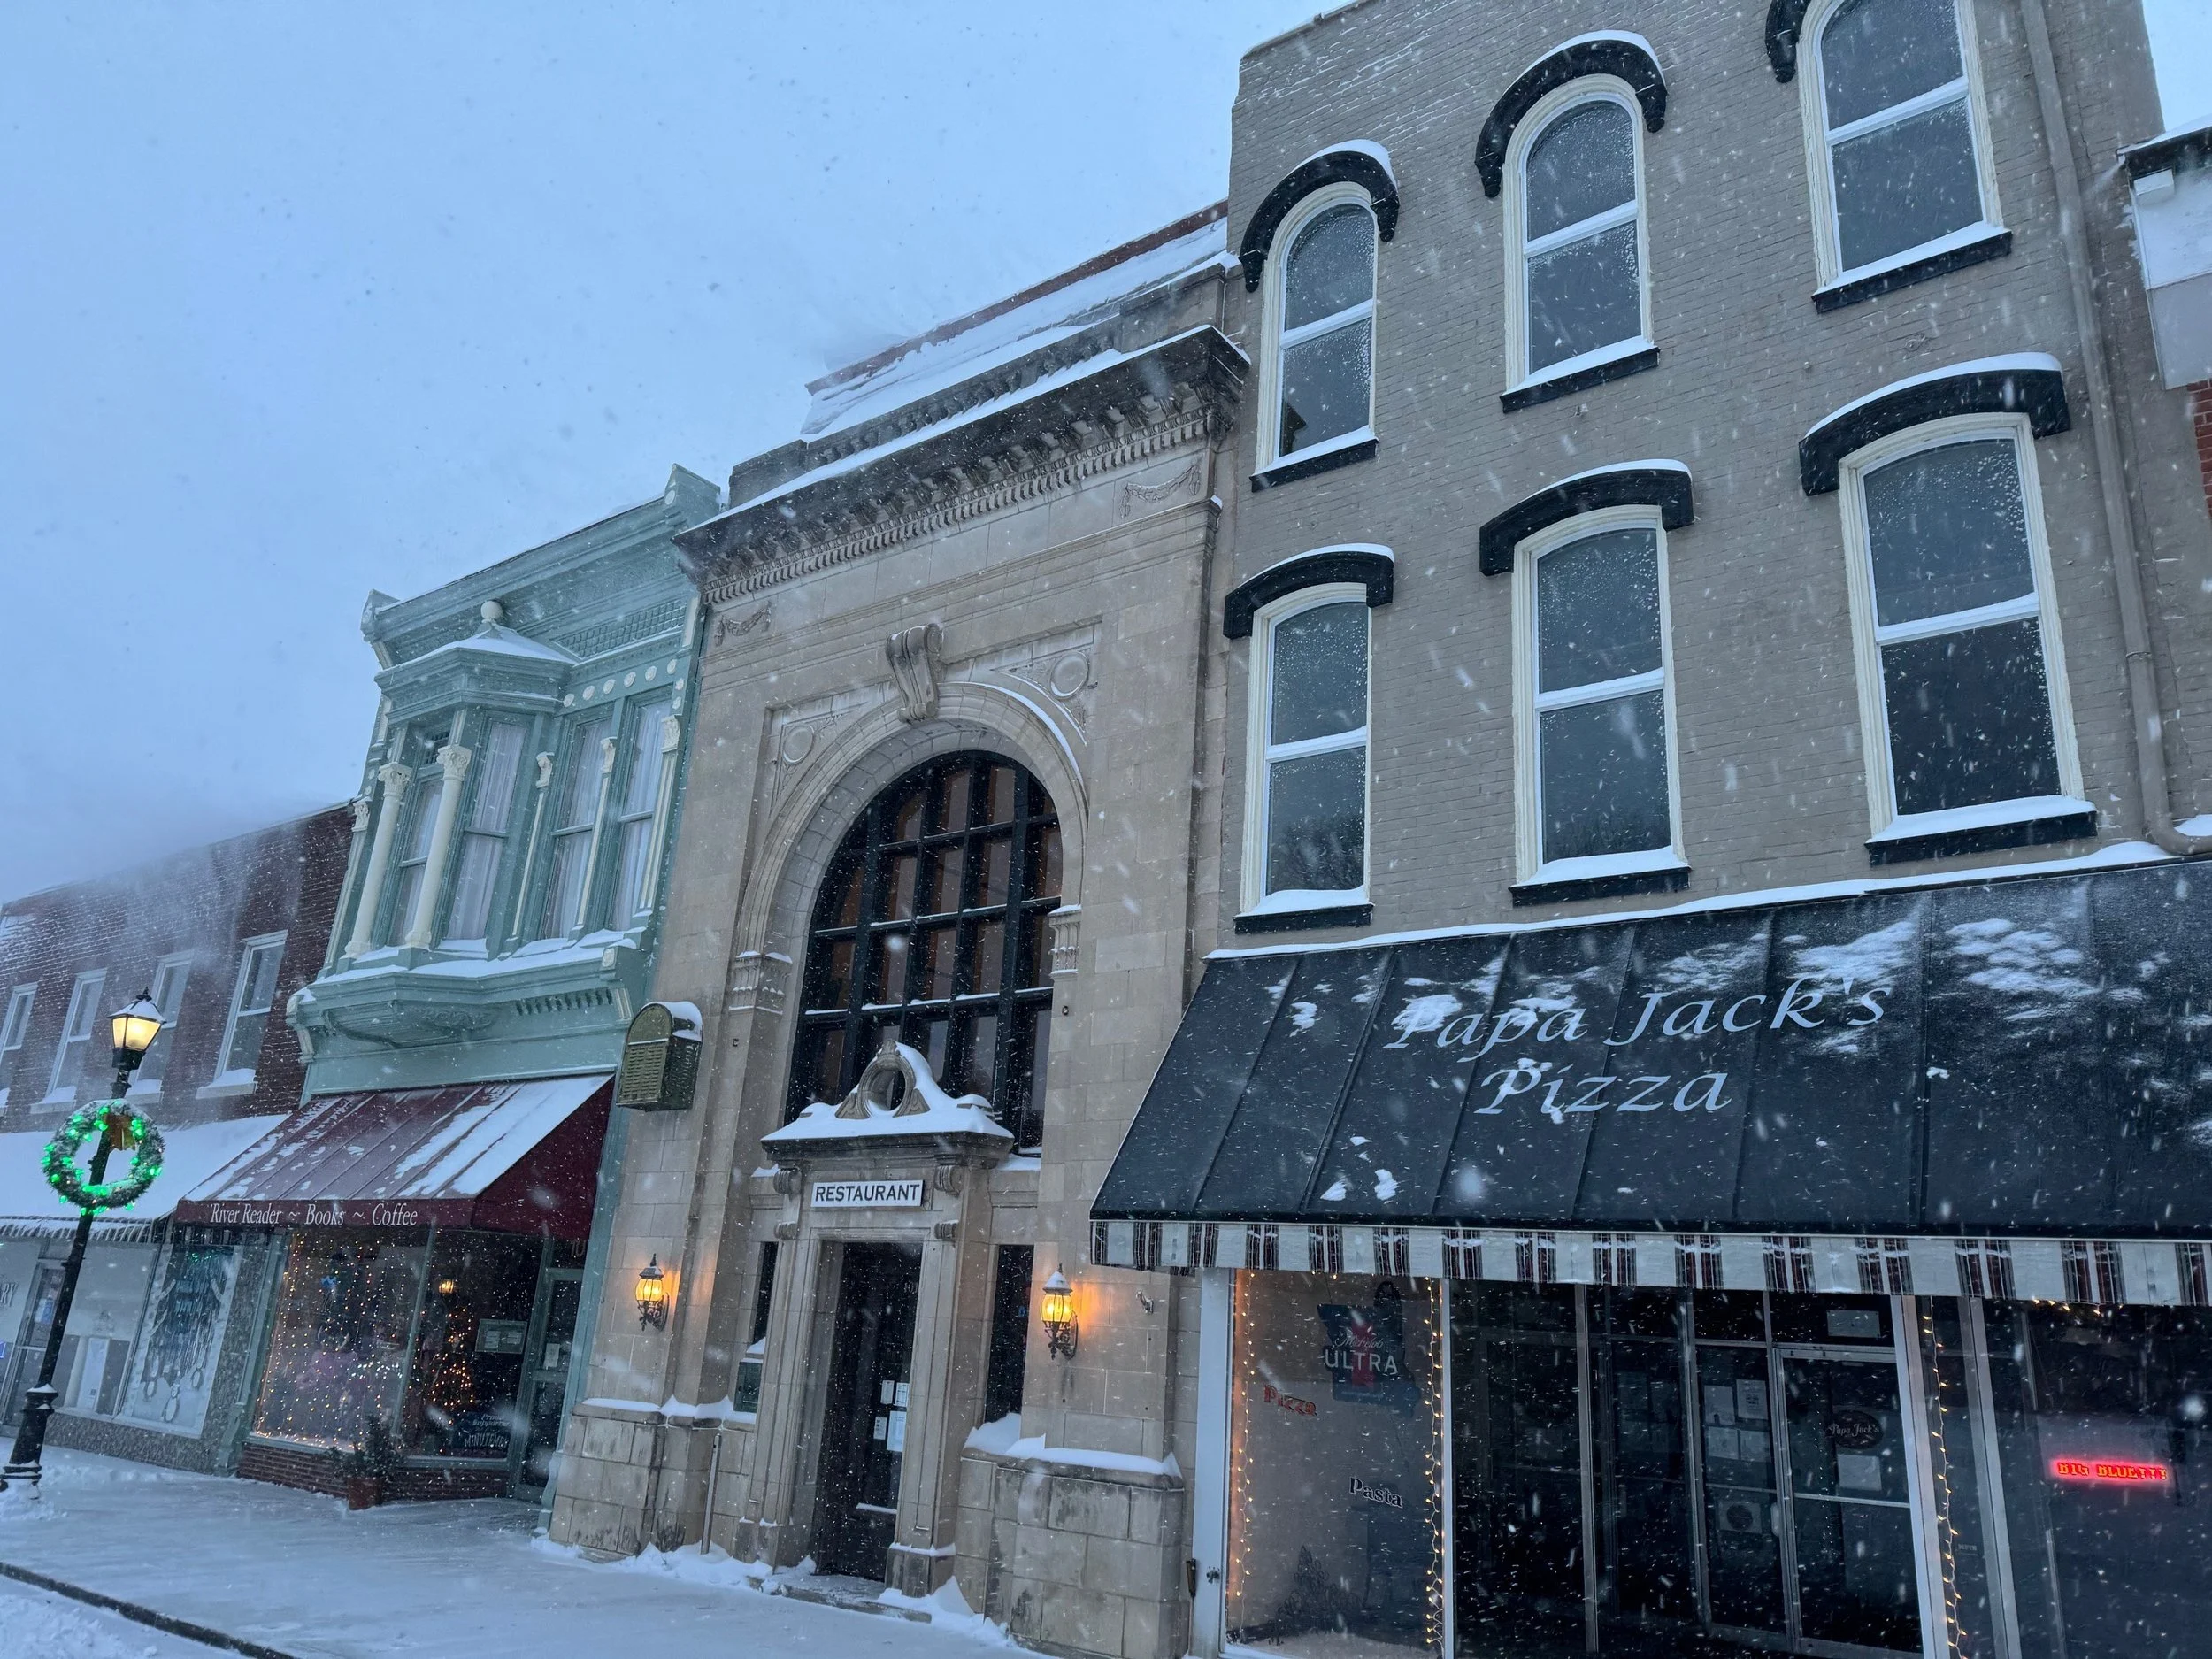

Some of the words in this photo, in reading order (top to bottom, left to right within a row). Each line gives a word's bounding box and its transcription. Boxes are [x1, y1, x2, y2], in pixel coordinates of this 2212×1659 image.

[1383, 1007, 1589, 1063] Papa
[1602, 974, 1893, 1047] Jack's
[1474, 1064, 1732, 1115] Pizza
[815, 1184, 920, 1202] RESTAURANT
[210, 1202, 240, 1224] River
[242, 1202, 283, 1225] Reader
[304, 1202, 346, 1225] Books
[372, 1202, 419, 1226] Coffee
[0, 1282, 19, 1307] RY
[1325, 1349, 1398, 1375] ULTRA
[1263, 1384, 1317, 1416] Pizza
[2057, 1462, 2089, 1476] BIG
[1348, 1477, 1403, 1509] Pasta
